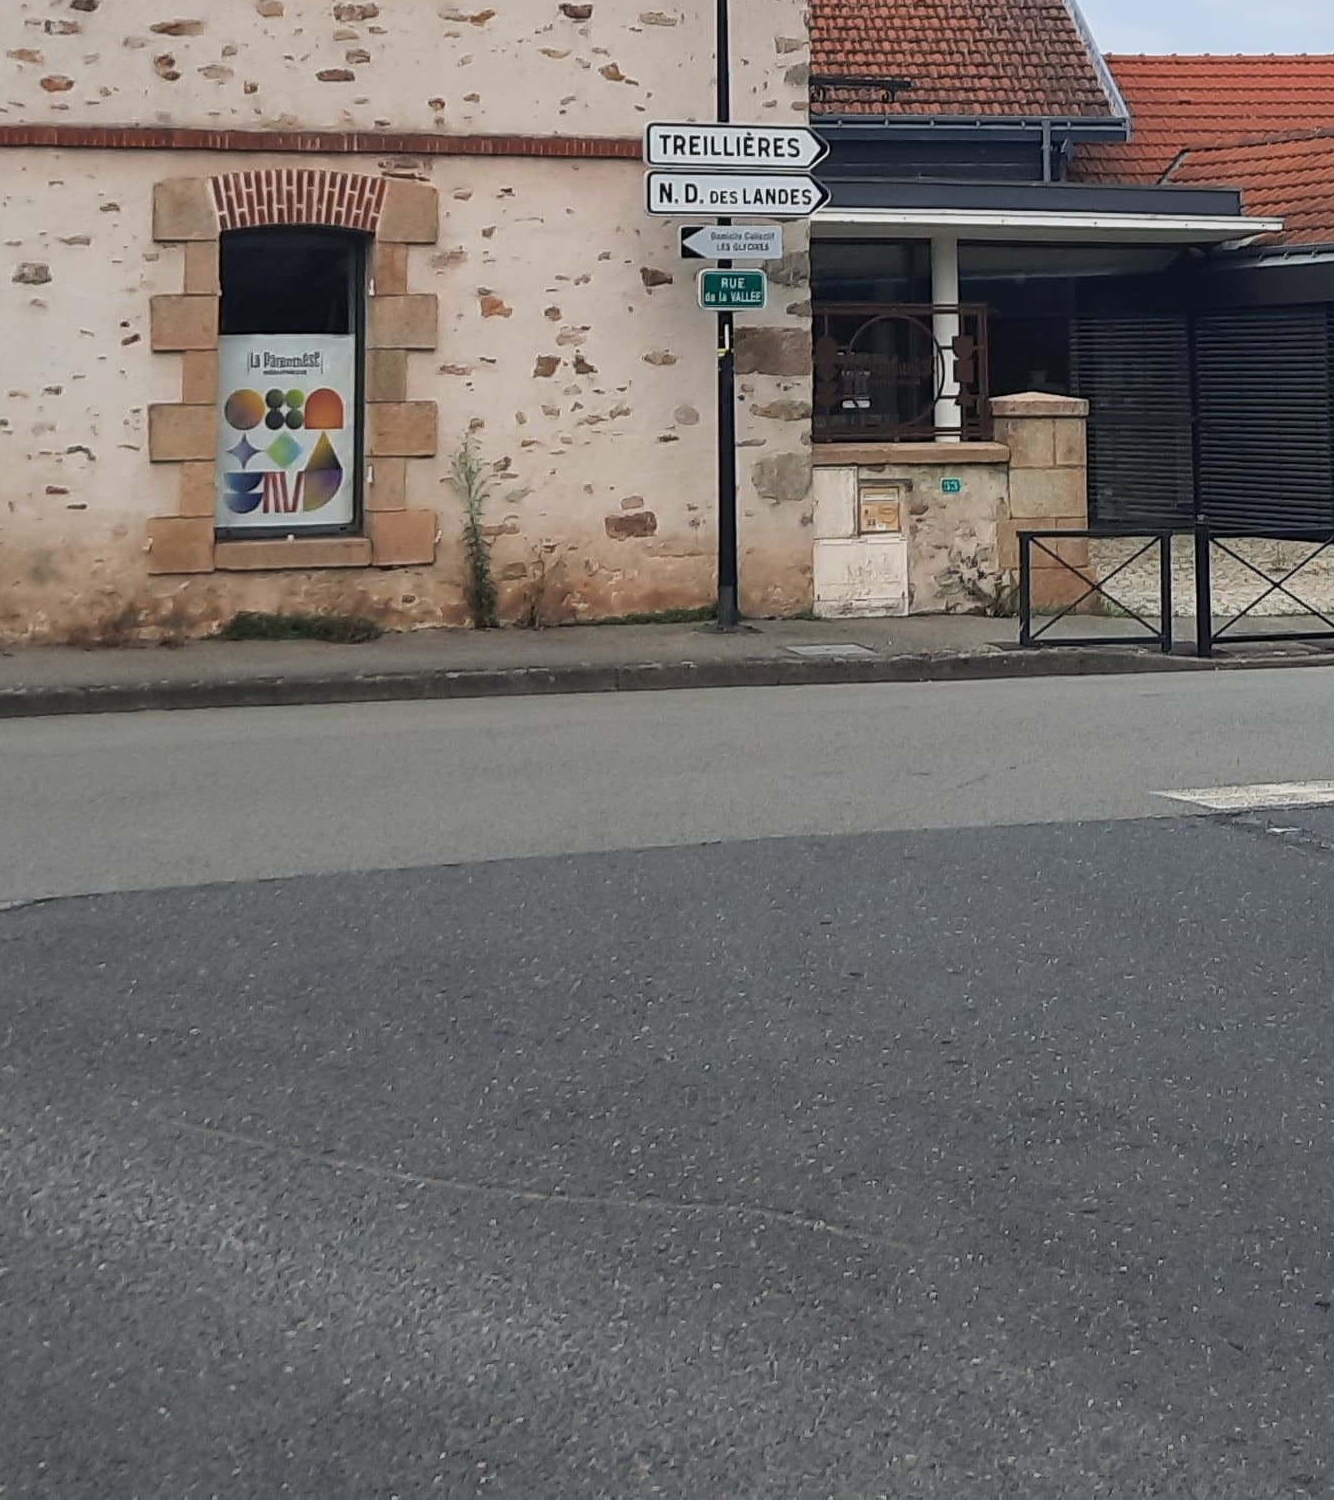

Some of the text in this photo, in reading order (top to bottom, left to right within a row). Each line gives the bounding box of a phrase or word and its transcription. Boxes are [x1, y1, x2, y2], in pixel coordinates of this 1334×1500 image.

[659, 132, 800, 157] TREILLIÈRES
[659, 183, 812, 205] N. D. DES LANDES
[716, 243, 730, 251] LES
[721, 277, 745, 289] RUE
[705, 291, 716, 302] de
[718, 290, 728, 302] la
[251, 352, 260, 367] La
